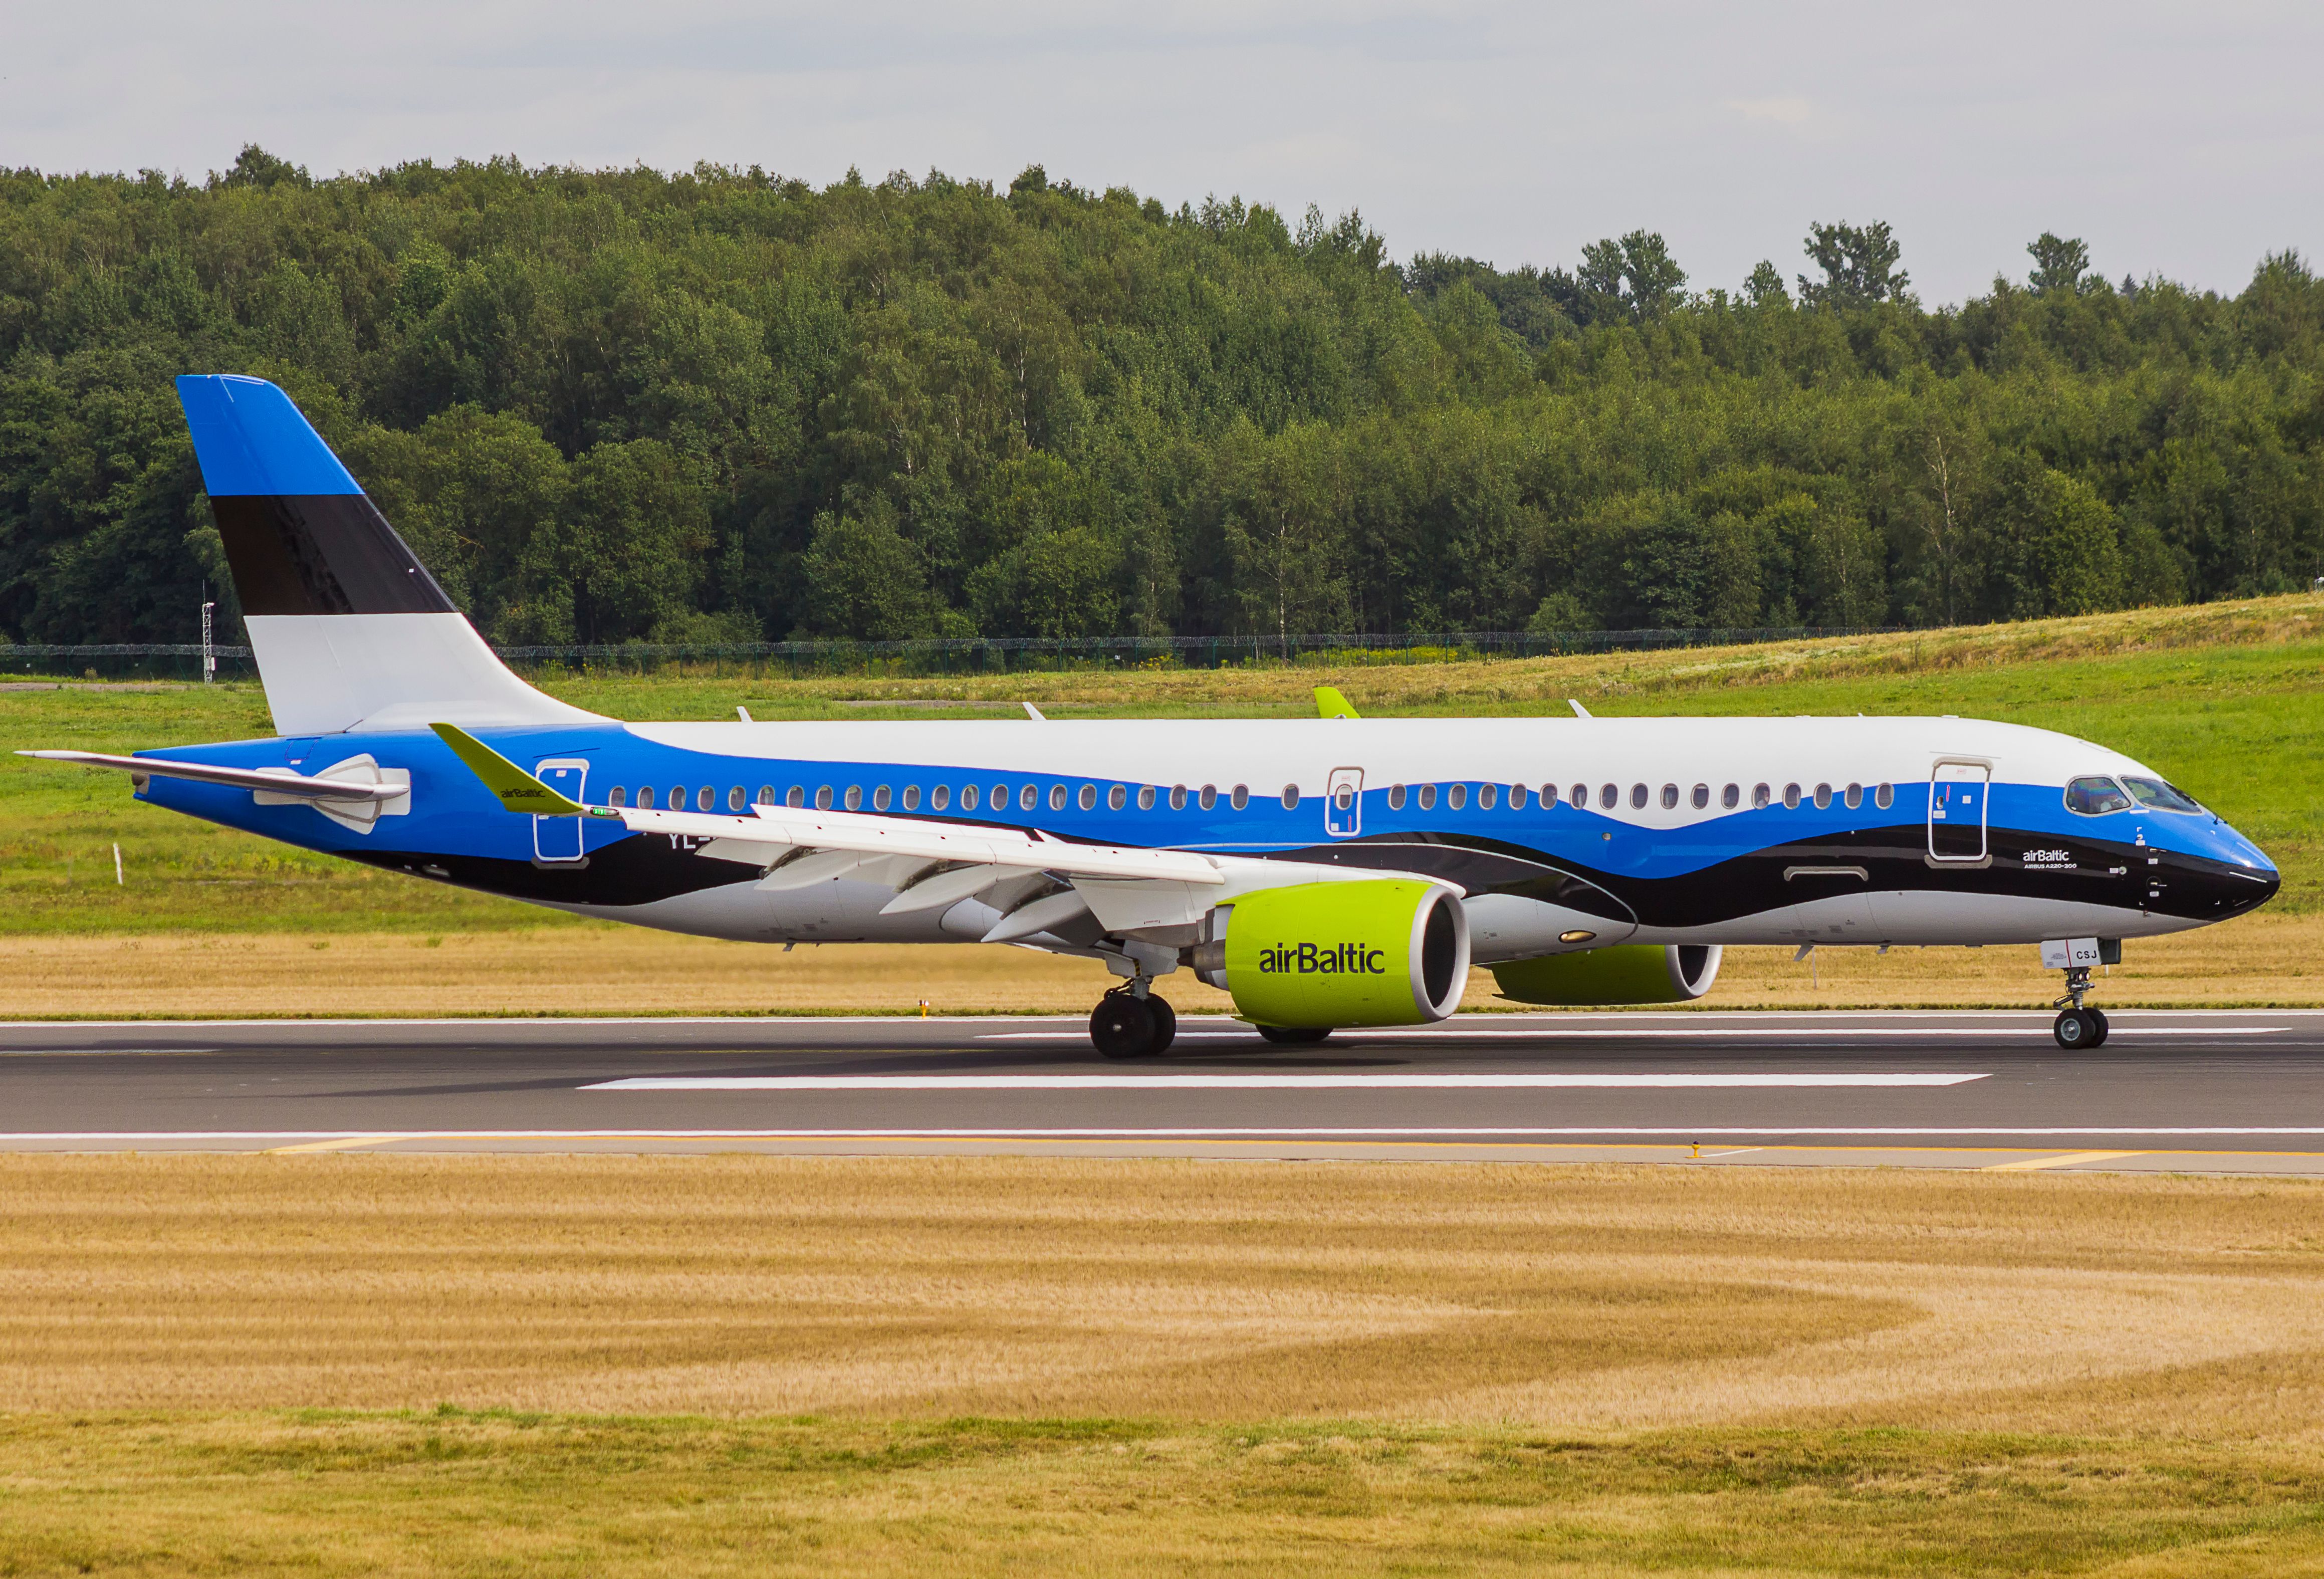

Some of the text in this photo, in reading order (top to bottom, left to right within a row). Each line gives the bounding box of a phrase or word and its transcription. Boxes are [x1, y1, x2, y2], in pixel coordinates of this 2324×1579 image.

[501, 789, 546, 798] airBaltic
[2023, 850, 2069, 861] airBaltic
[1259, 943, 1385, 974] airBaltic
[2076, 950, 2097, 959] CSJ
